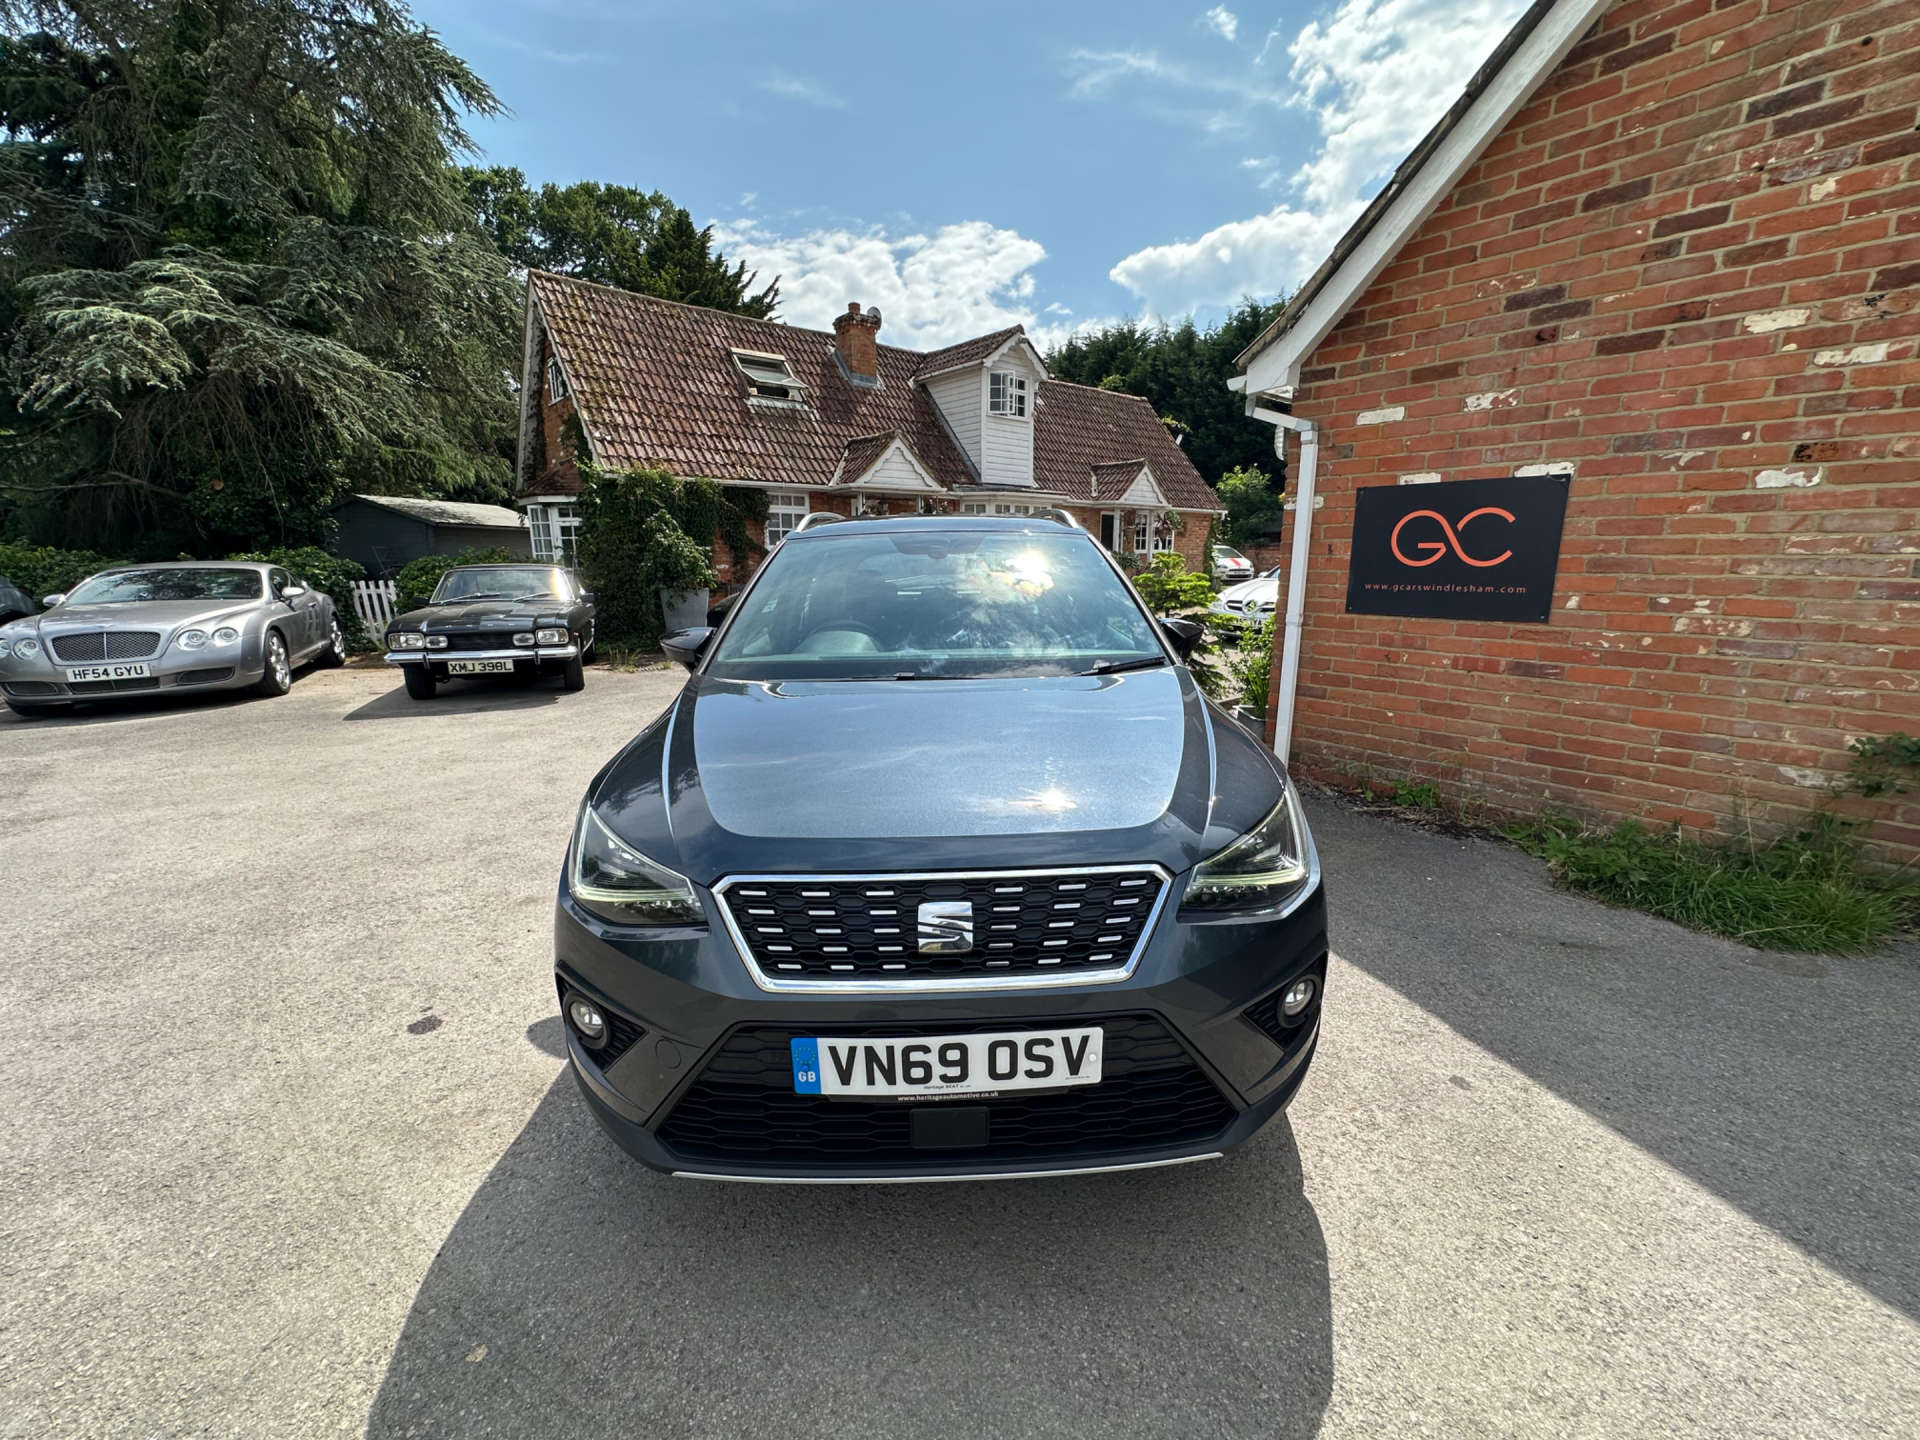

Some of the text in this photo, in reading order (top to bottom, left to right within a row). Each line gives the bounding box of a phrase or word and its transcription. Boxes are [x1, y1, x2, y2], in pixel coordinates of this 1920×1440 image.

[1364, 582, 1527, 594] www.gcarswindlesham.com
[73, 665, 144, 679] HF54 GYU
[449, 661, 512, 673] XMJ 398L
[828, 1035, 1090, 1086] VN69 OSV
[798, 1071, 816, 1083] GB
[897, 1090, 999, 1102] www.heritageautomotive.co.uk
